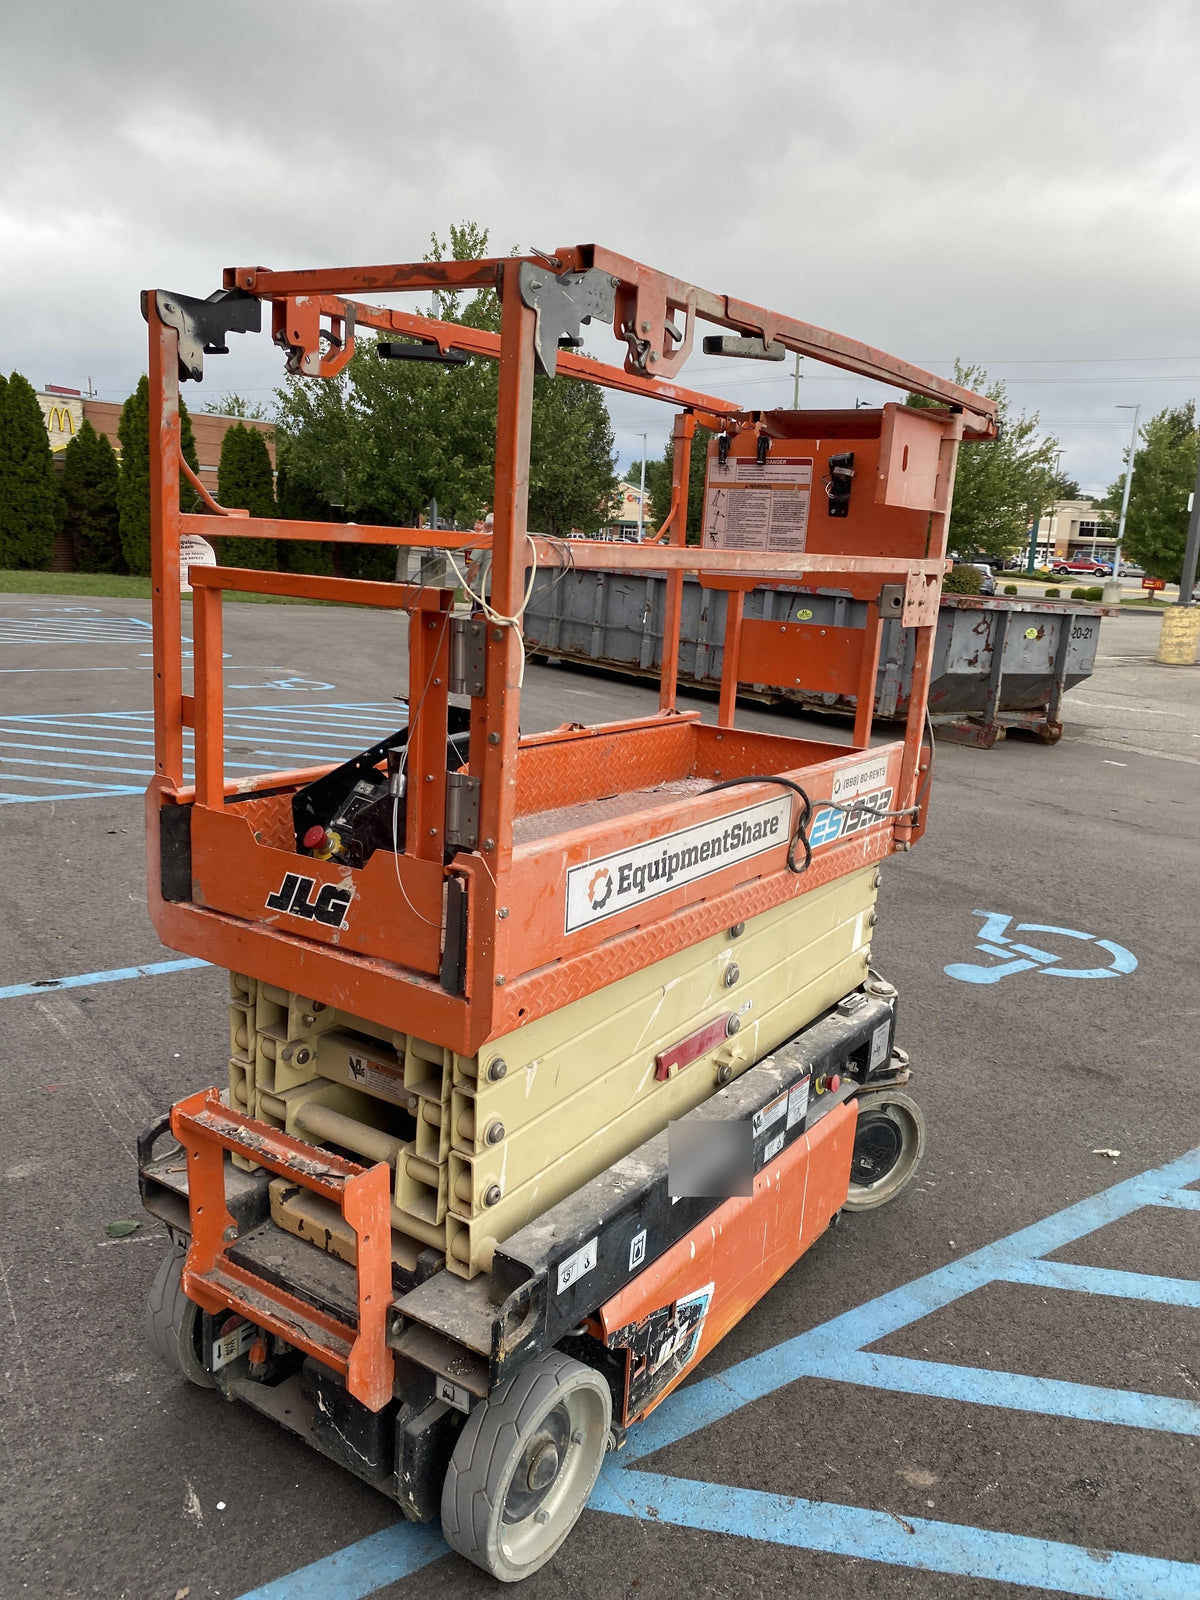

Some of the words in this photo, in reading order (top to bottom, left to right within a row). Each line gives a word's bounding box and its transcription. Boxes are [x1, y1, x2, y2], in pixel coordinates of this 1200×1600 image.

[1071, 627, 1093, 639] 20-21
[617, 815, 779, 895] EquipmentShare
[265, 871, 356, 930] JLG
